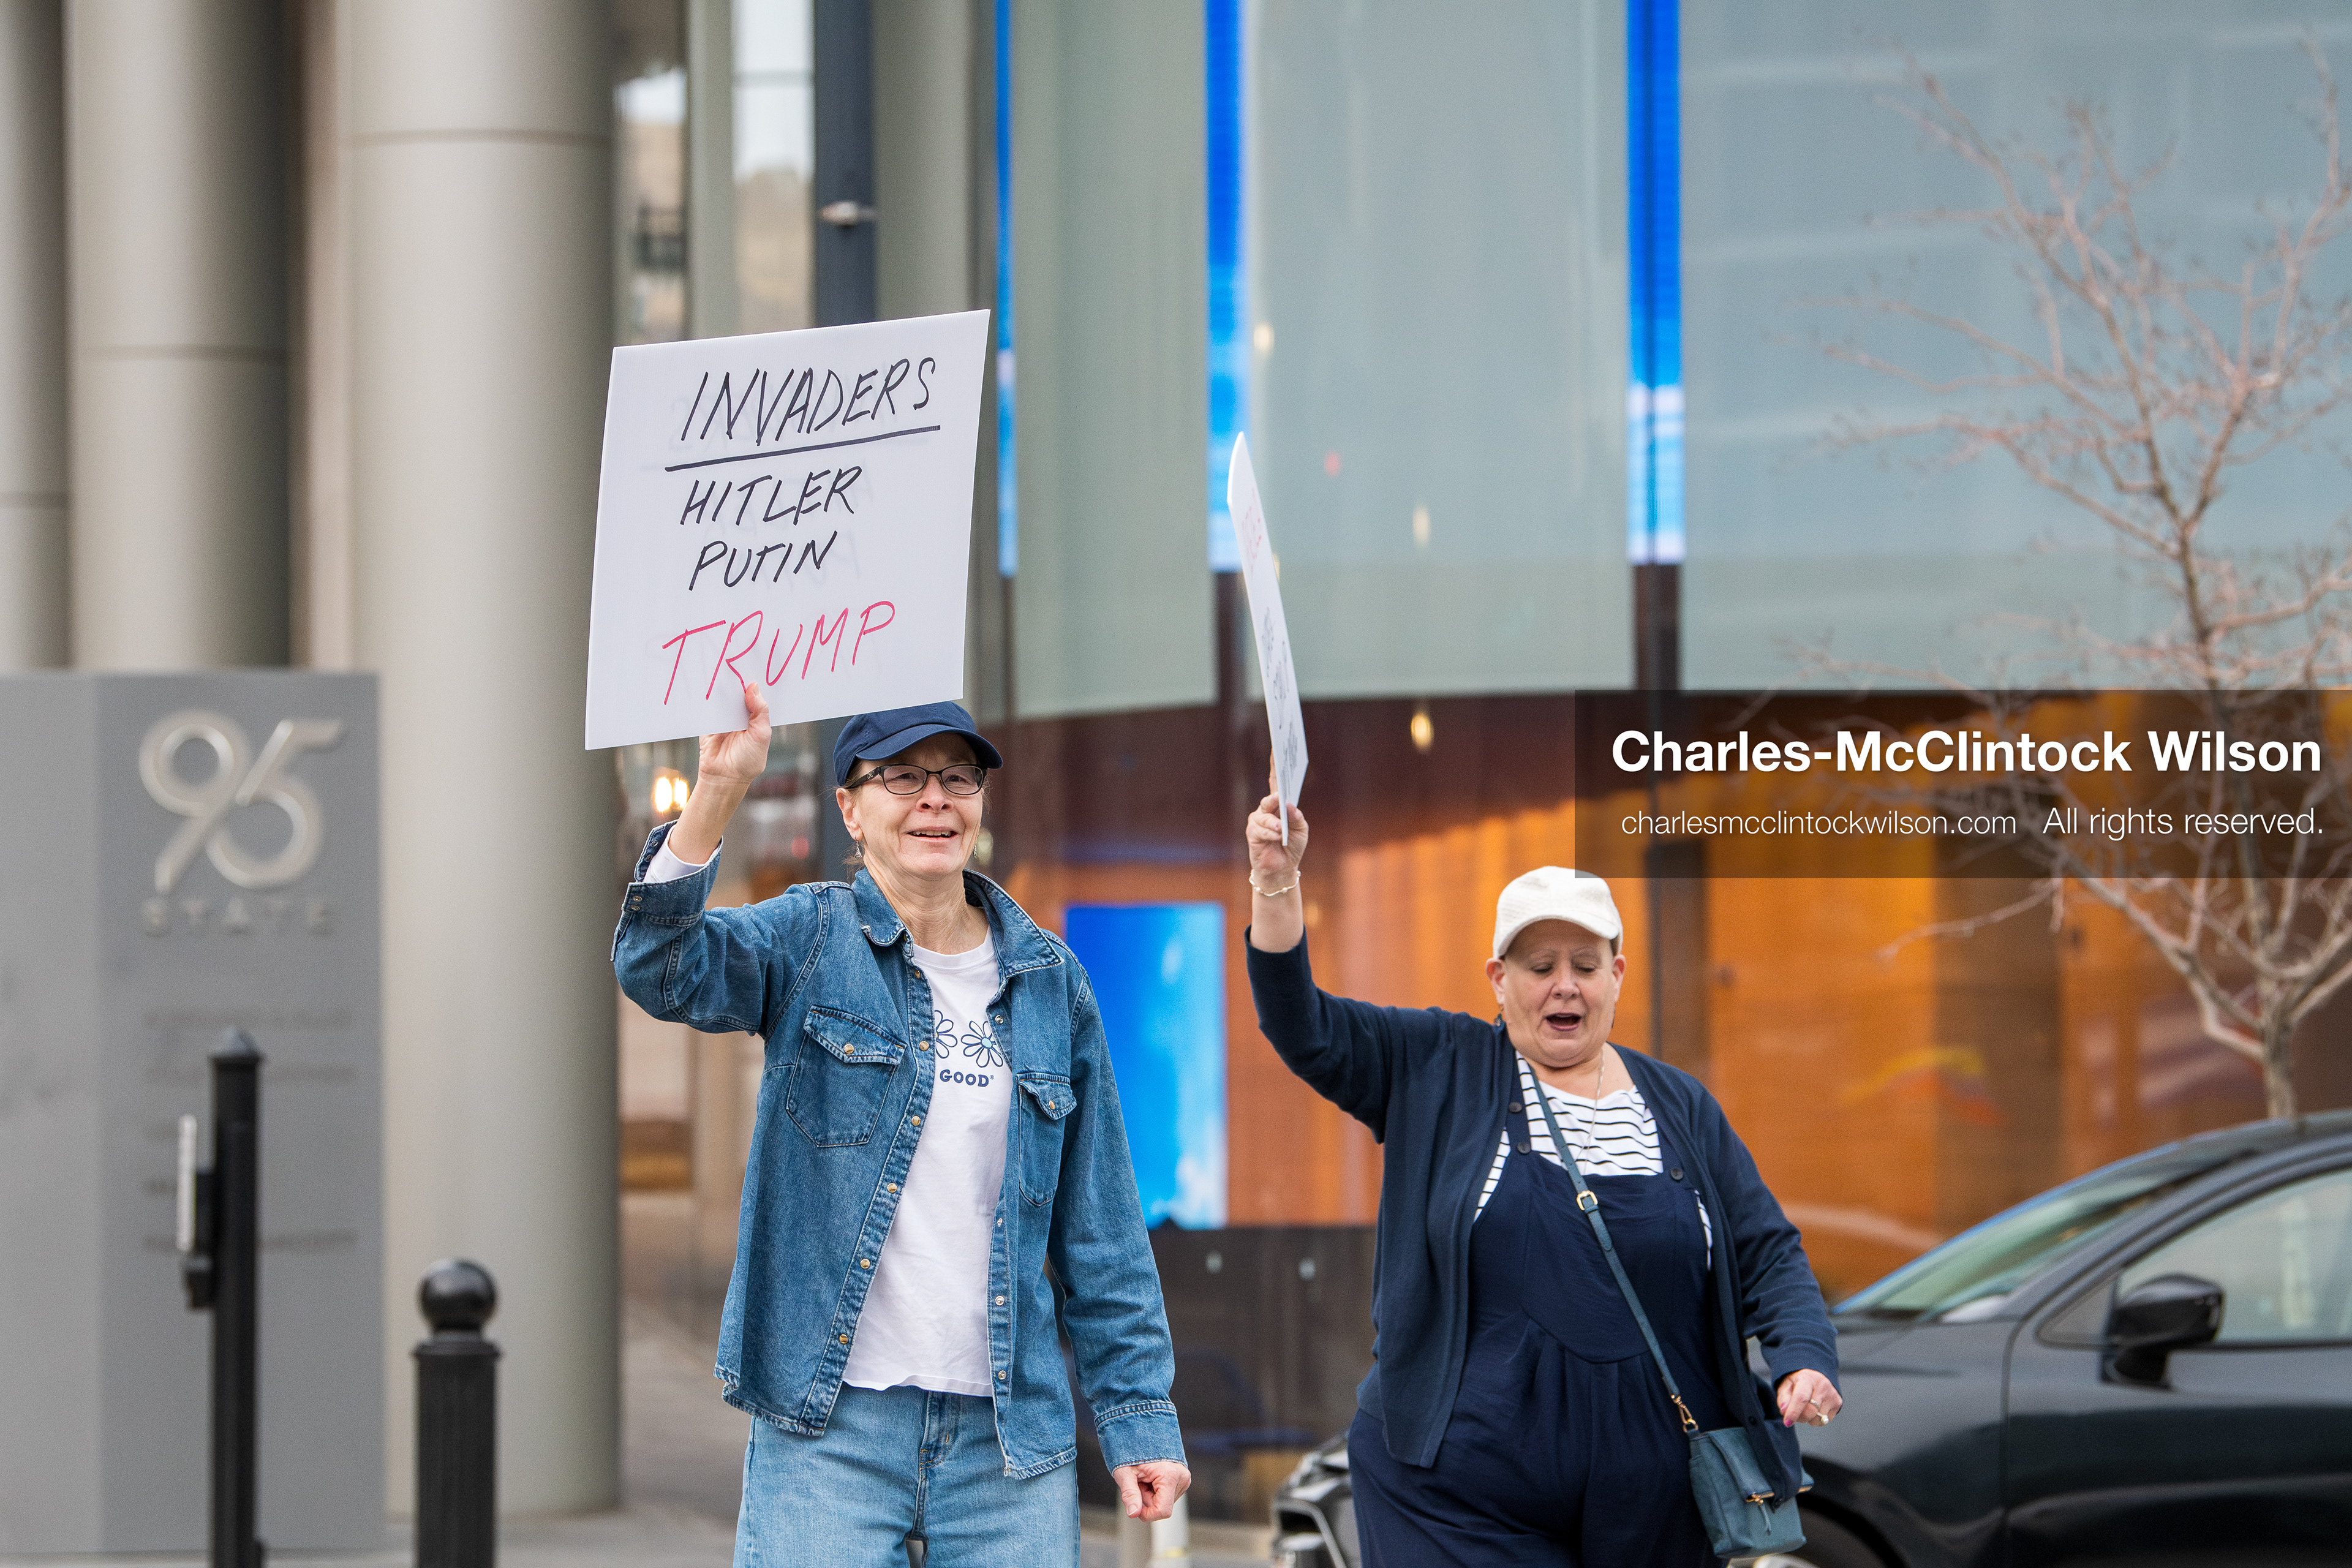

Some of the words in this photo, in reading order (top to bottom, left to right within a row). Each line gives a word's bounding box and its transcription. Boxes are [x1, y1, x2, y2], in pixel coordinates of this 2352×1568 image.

[681, 357, 936, 446] INVADERS
[680, 466, 862, 526] HITLER
[690, 531, 839, 592] PUTIN
[662, 601, 896, 705] TRUMP
[139, 709, 345, 893] 95
